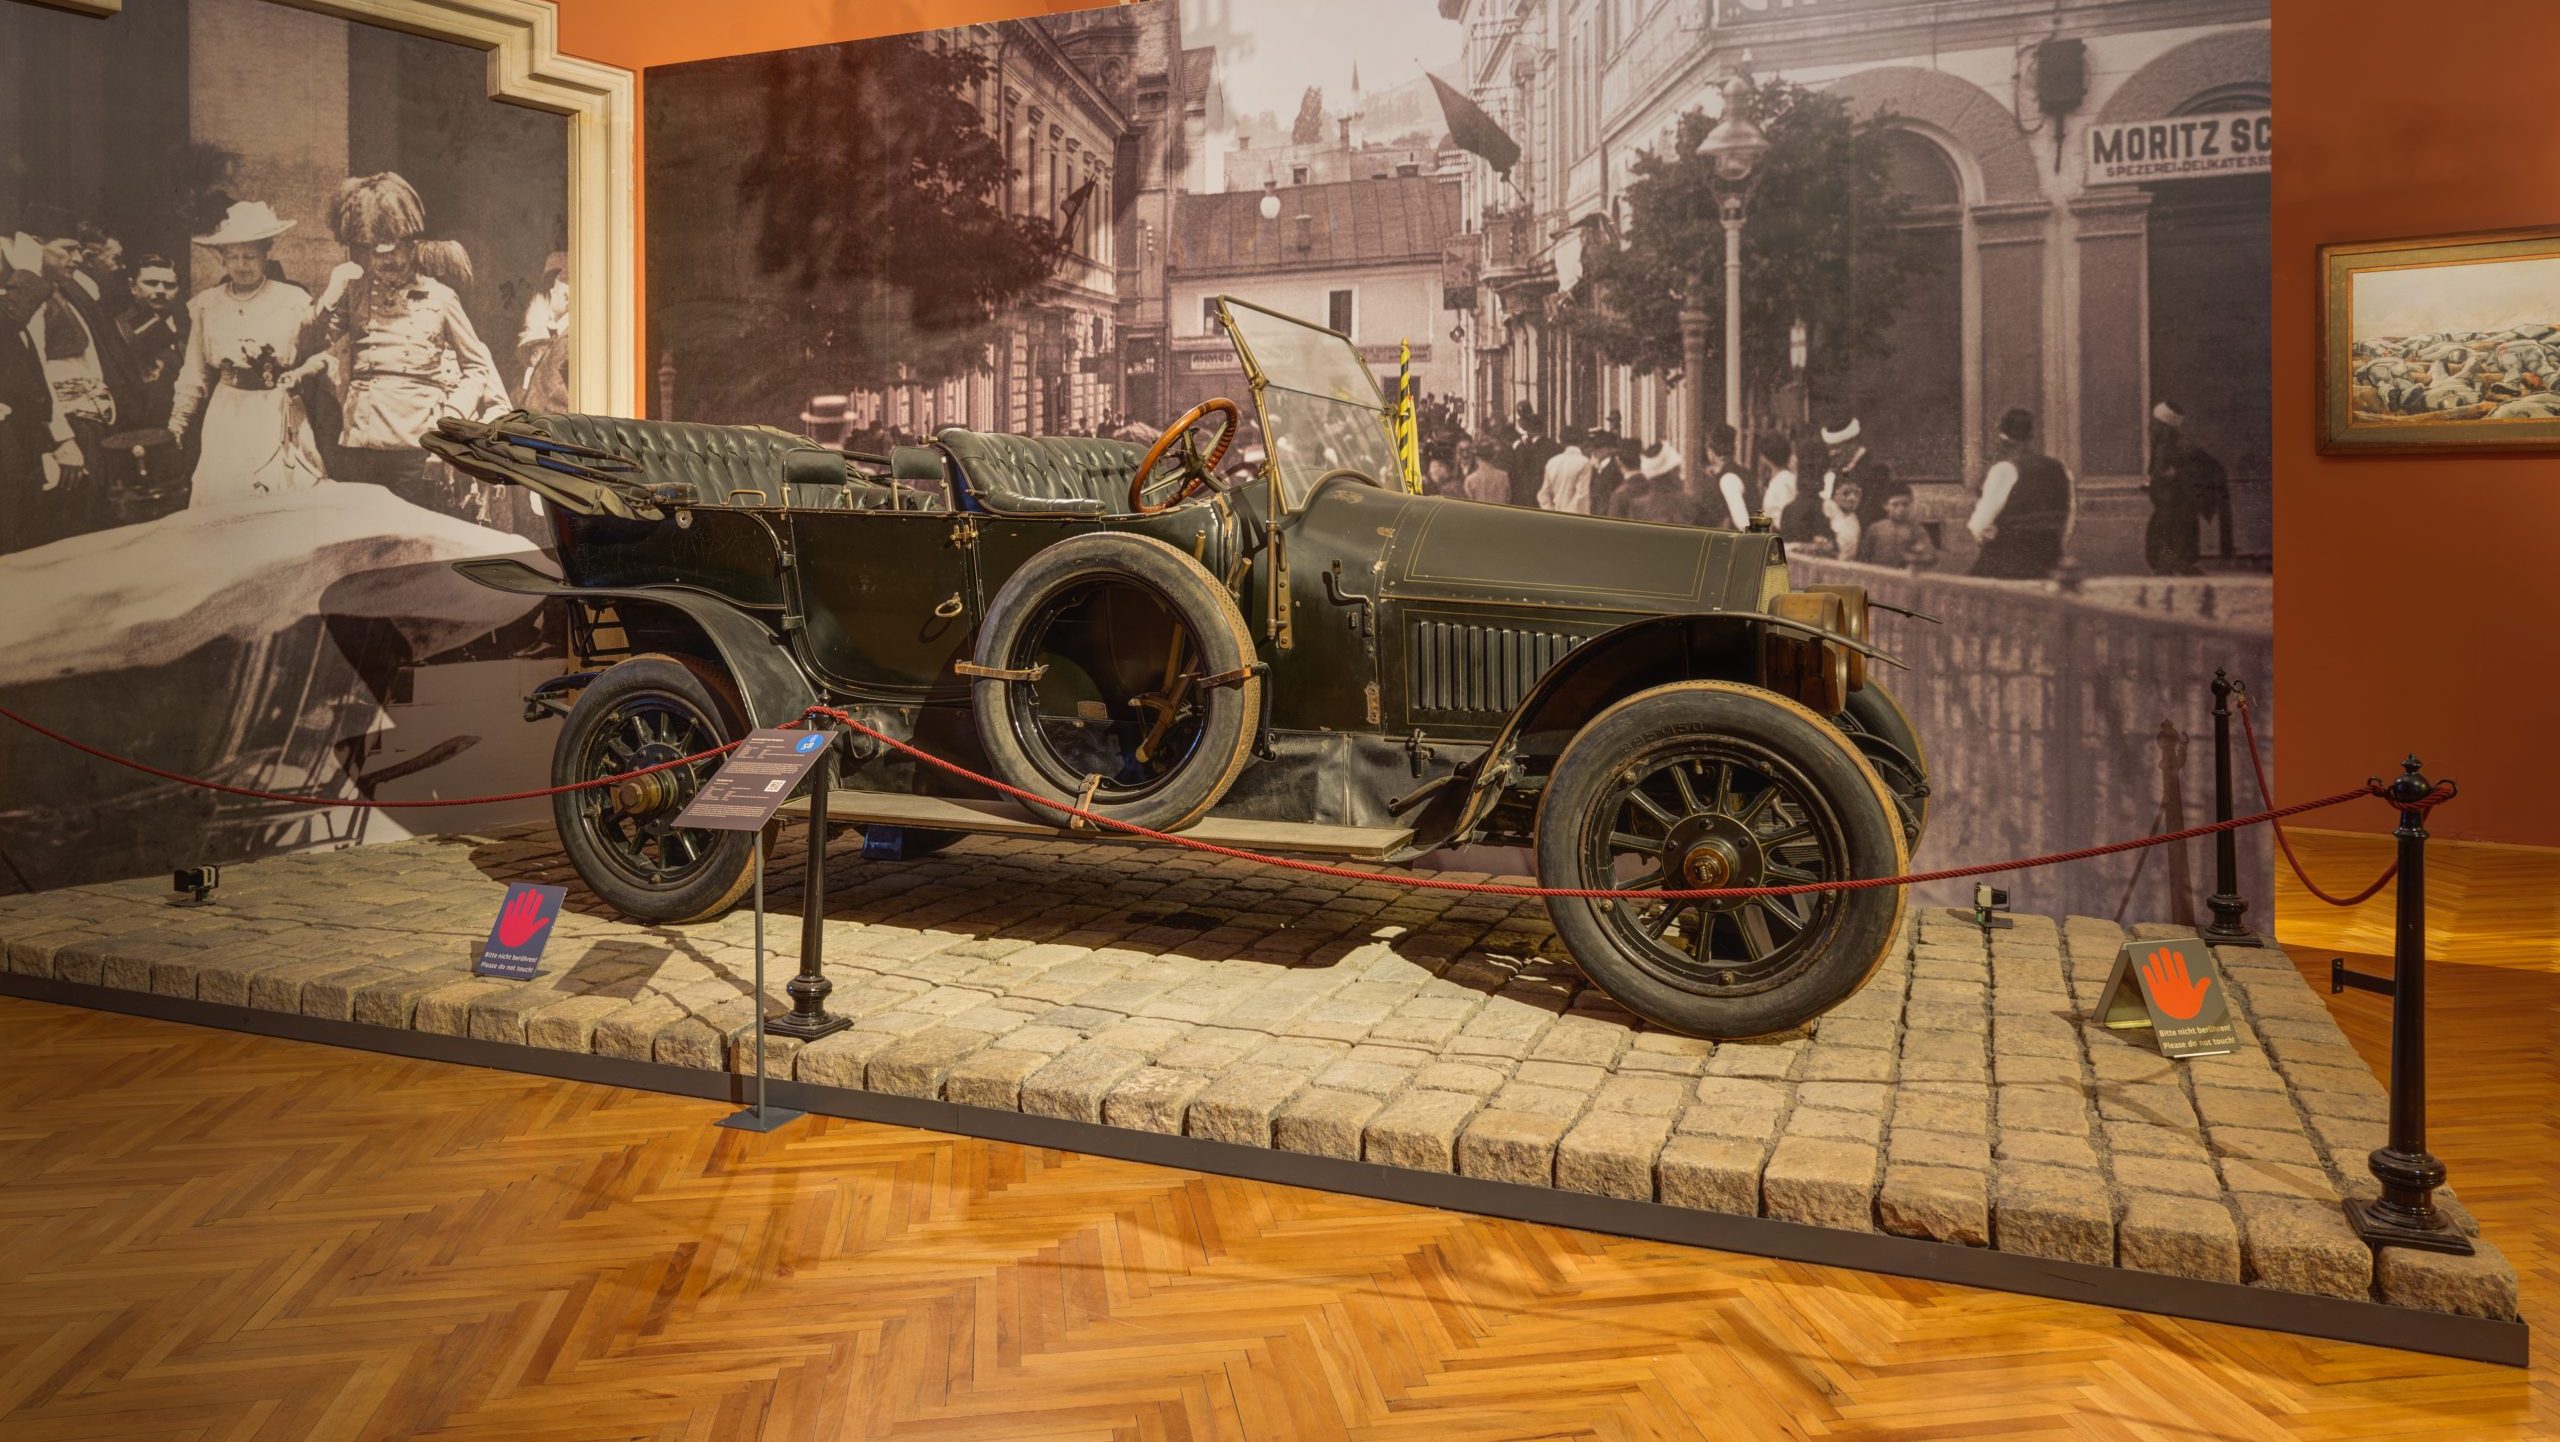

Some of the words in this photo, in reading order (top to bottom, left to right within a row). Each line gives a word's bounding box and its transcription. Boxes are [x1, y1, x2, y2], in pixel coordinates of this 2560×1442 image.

[2093, 120, 2219, 164] MORITZ
[2231, 116, 2272, 153] SC
[480, 961, 498, 969] Please
[2159, 1029, 2177, 1038] Bitte
[2177, 1026, 2196, 1036] nicht
[2196, 1024, 2232, 1035] berühren!
[2162, 1041, 2187, 1050] Please
[2187, 1039, 2198, 1048] do
[2199, 1039, 2212, 1047] not
[2212, 1036, 2236, 1046] touch!
